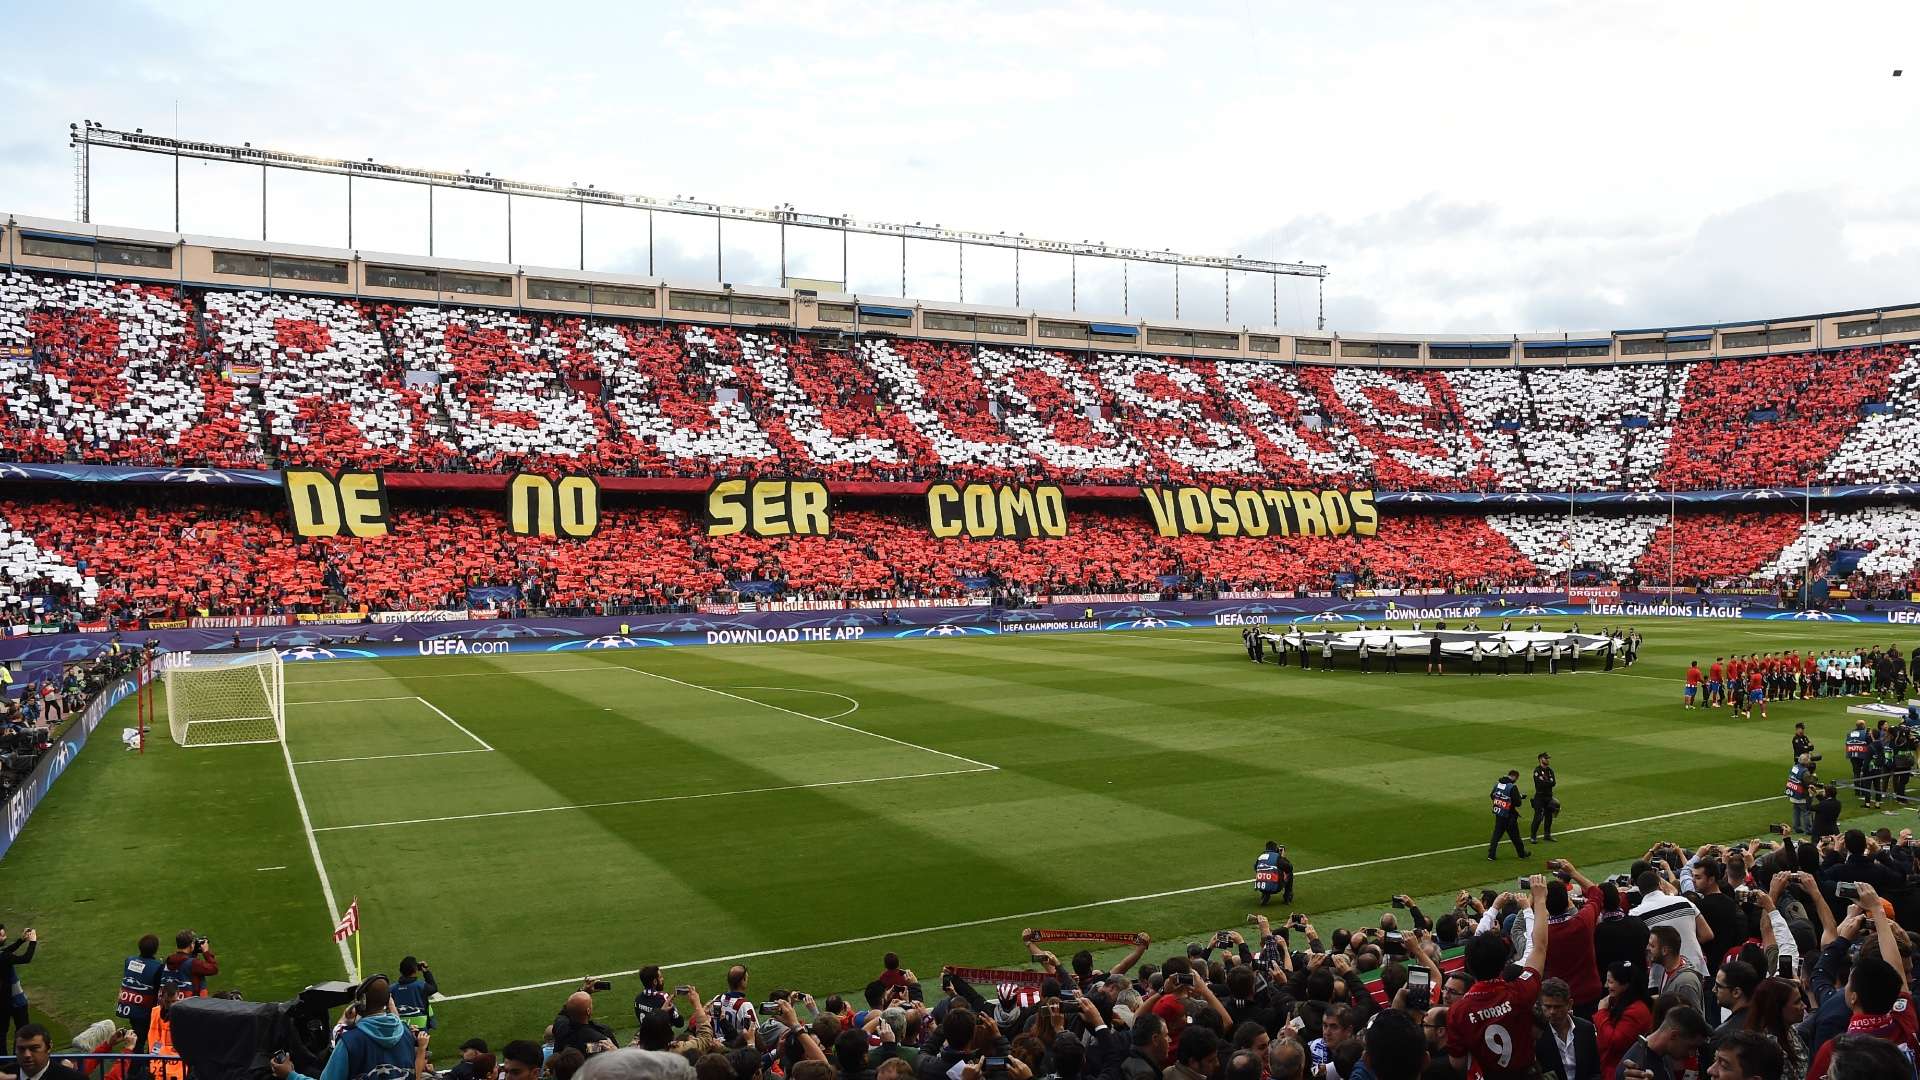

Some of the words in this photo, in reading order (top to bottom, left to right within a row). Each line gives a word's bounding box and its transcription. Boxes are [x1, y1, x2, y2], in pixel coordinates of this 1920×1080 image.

[287, 471, 387, 537] DE
[512, 474, 597, 536] NO
[708, 480, 830, 536] SER
[928, 484, 1067, 538] COMO
[1144, 487, 1378, 537] VOSOTROS
[1569, 590, 1618, 598] ORGULLO
[770, 600, 844, 612] MIGUELTURRA
[858, 600, 892, 609] SANTA
[895, 600, 917, 608] ANA
[918, 600, 931, 608] DE
[1592, 604, 1624, 616] UEFA
[1626, 604, 1693, 617] CHAMPIONS
[1696, 606, 1742, 618] LEAGUE
[1215, 614, 1268, 626] UEFA.com
[1385, 608, 1442, 620] DOWNLOAD
[1443, 607, 1462, 618] THE
[1463, 607, 1481, 617] APP
[191, 616, 239, 629] CASTILLO
[240, 616, 254, 627] DE
[255, 614, 287, 627] LORCA
[1003, 623, 1023, 632] UEFA
[1025, 621, 1068, 631] CHAMPIONS
[1070, 620, 1098, 630] LEAGUE
[707, 628, 799, 645] DOWNLOAD
[802, 627, 832, 641] THE
[835, 626, 864, 640] APP
[419, 639, 509, 656] UEFA.com
[1469, 1012, 1478, 1024] F.
[1479, 1000, 1512, 1021] TORRES
[1484, 1023, 1513, 1068] 9
